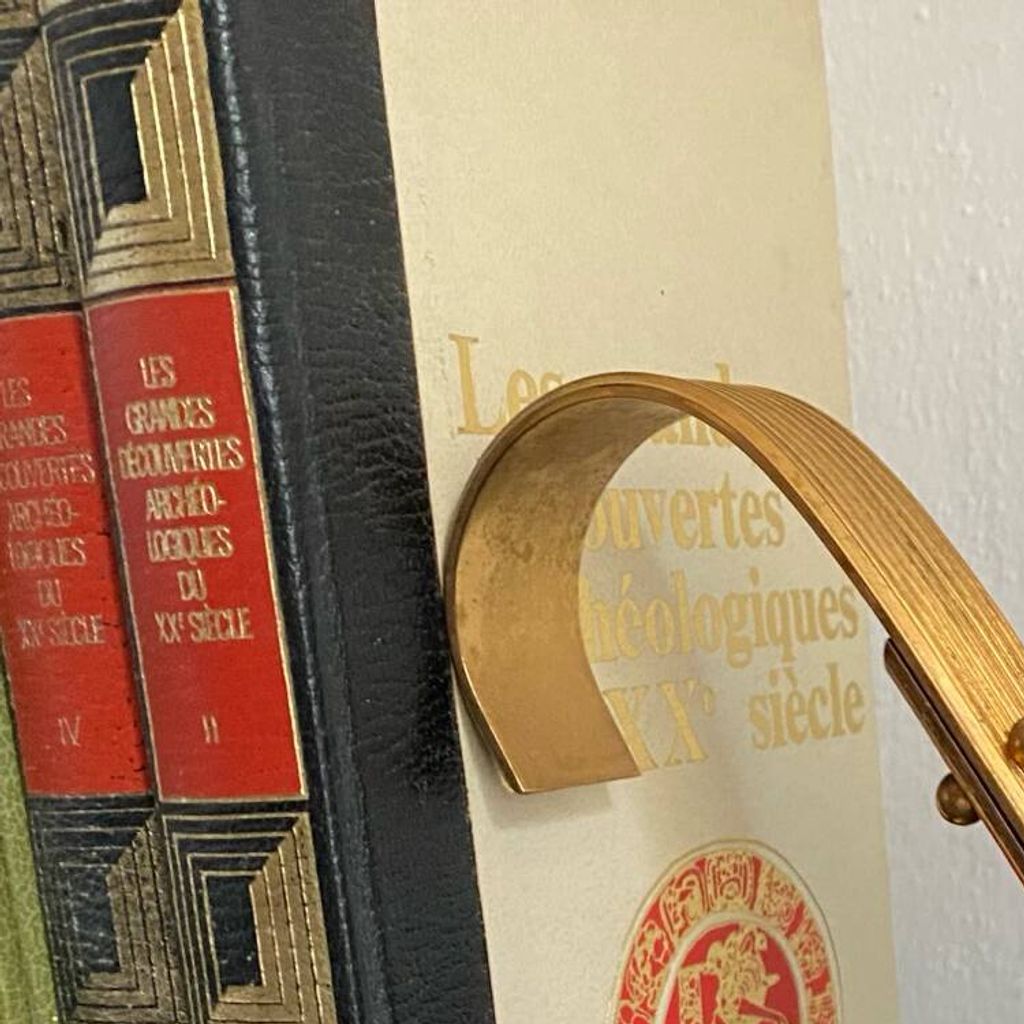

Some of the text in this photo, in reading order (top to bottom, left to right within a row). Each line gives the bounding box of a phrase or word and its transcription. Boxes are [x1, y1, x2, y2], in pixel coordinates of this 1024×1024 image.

[139, 355, 176, 389] LES
[0, 413, 67, 449] RANDES
[125, 396, 215, 435] GRANDES
[118, 436, 245, 480] DÉCOUVERTES
[146, 478, 227, 522] ARCHÉO-
[584, 470, 787, 550] ouvertes
[146, 525, 234, 566] LOGIQUES
[36, 578, 63, 608] DU
[177, 569, 207, 601] DU
[186, 602, 254, 643] SIÈCLE
[579, 566, 859, 669] héologiques
[749, 661, 866, 751] siècle
[202, 714, 220, 745] II
